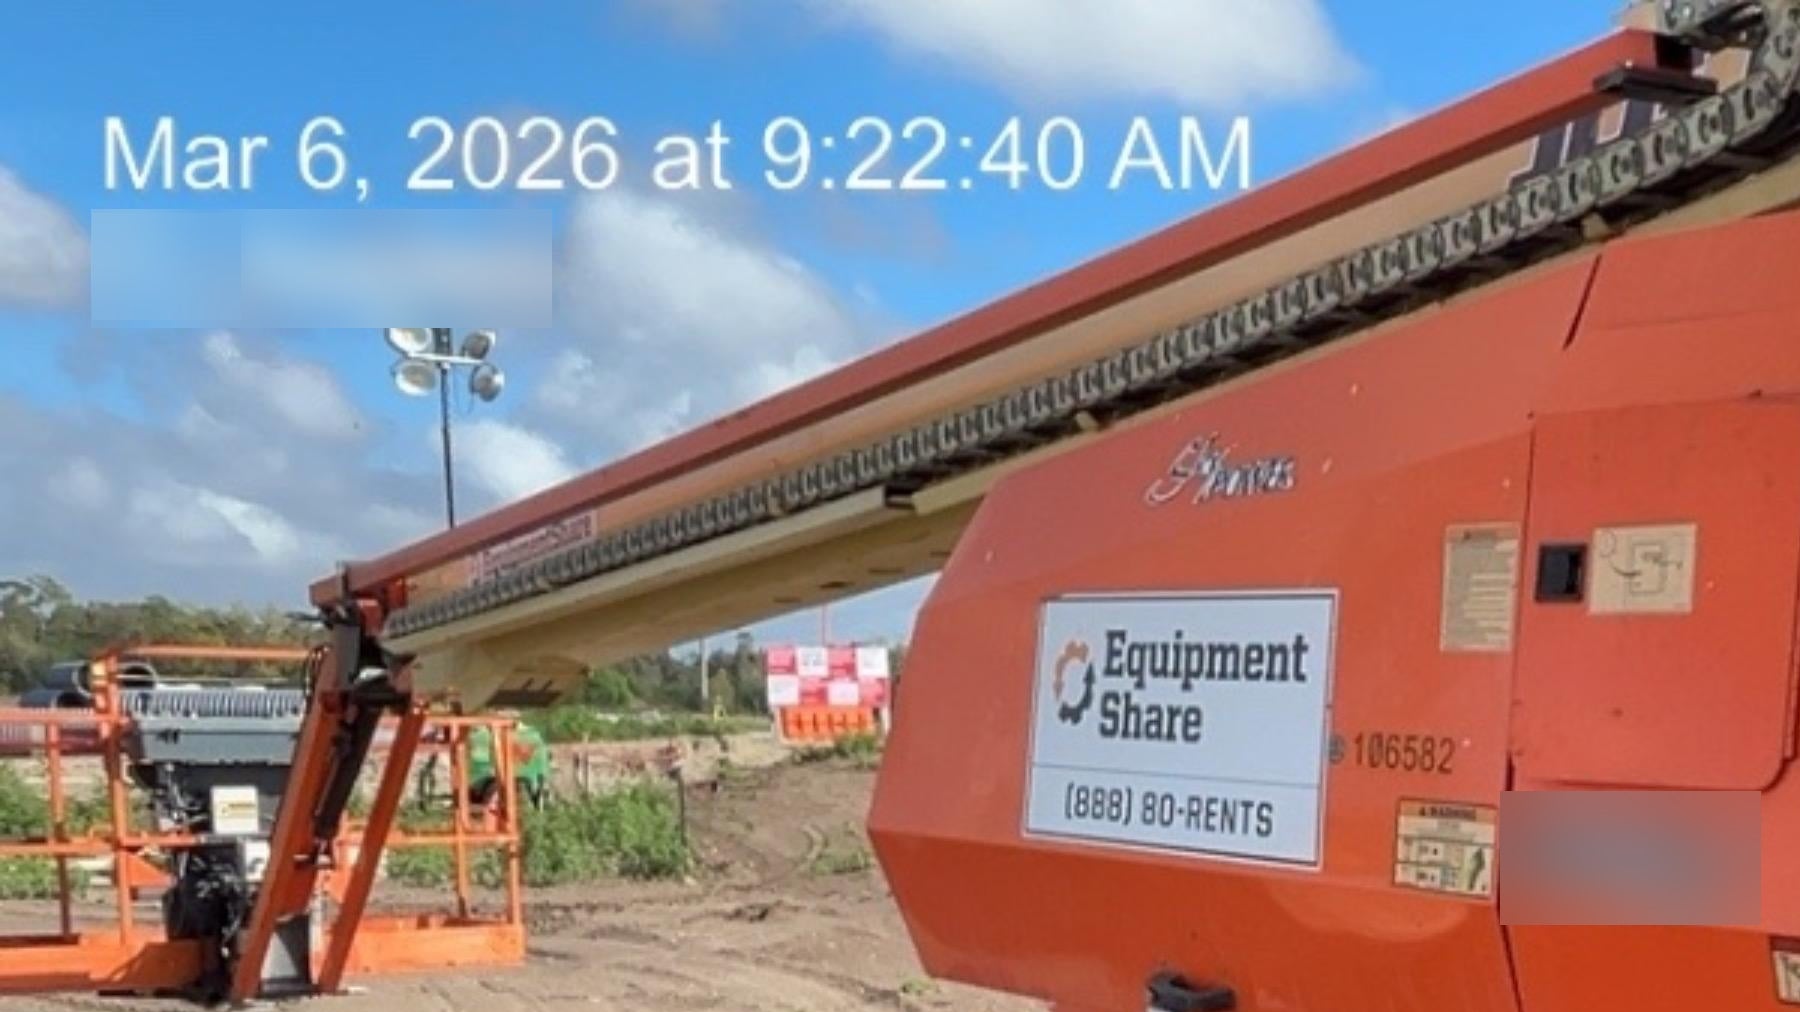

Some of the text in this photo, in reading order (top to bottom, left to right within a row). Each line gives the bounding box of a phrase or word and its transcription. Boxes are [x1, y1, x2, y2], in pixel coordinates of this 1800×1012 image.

[1103, 629, 1309, 691] Equipment
[1099, 691, 1201, 743] Share
[1353, 731, 1455, 774] 106582
[1064, 781, 1274, 838] (888) 80-RENTS
